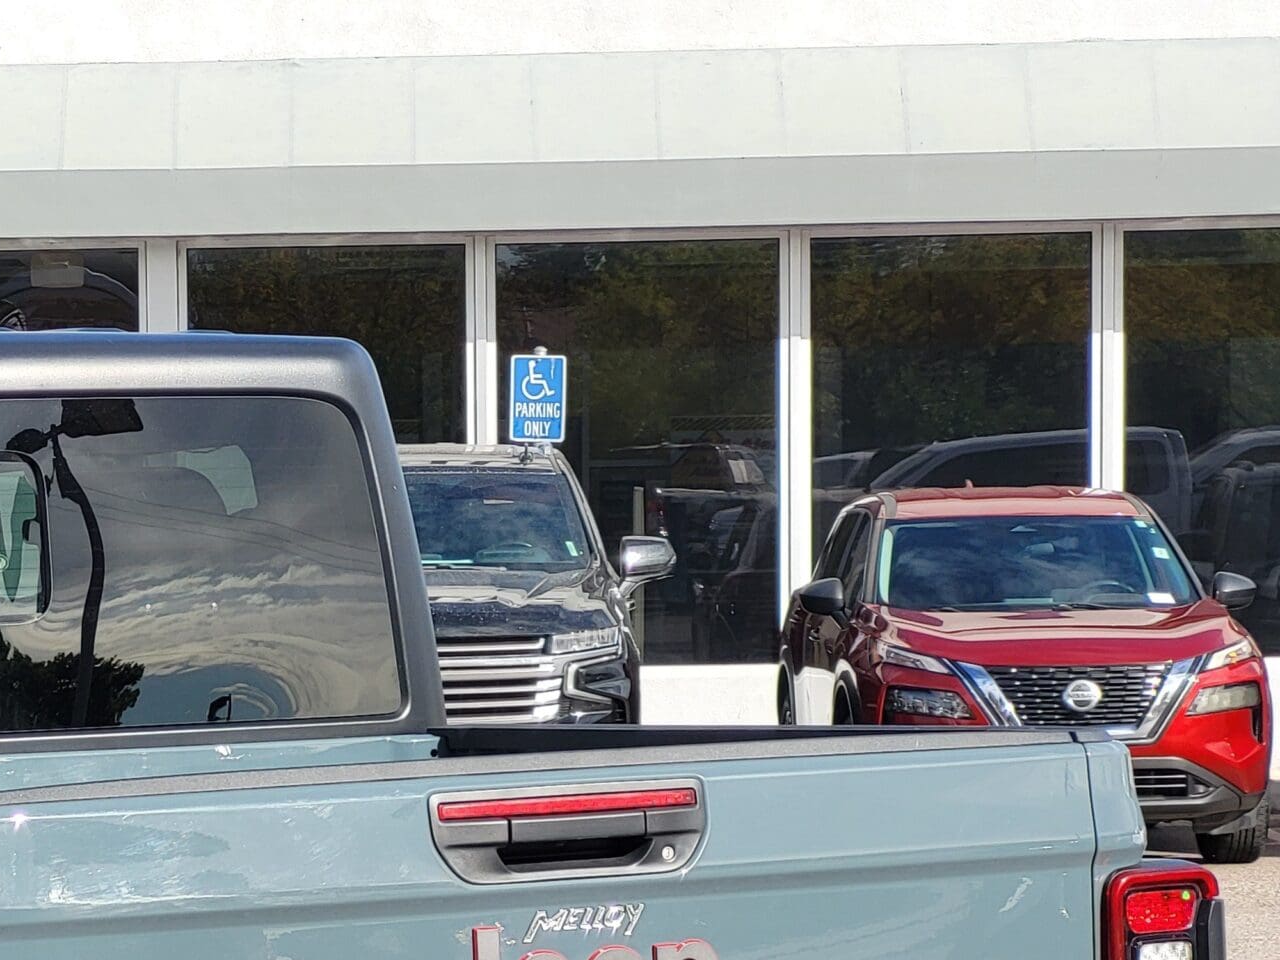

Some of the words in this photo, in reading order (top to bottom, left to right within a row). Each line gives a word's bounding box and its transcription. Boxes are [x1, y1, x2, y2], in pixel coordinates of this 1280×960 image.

[515, 402, 561, 418] PARKING
[524, 420, 551, 436] ONLY
[522, 902, 645, 944] MELLOY
